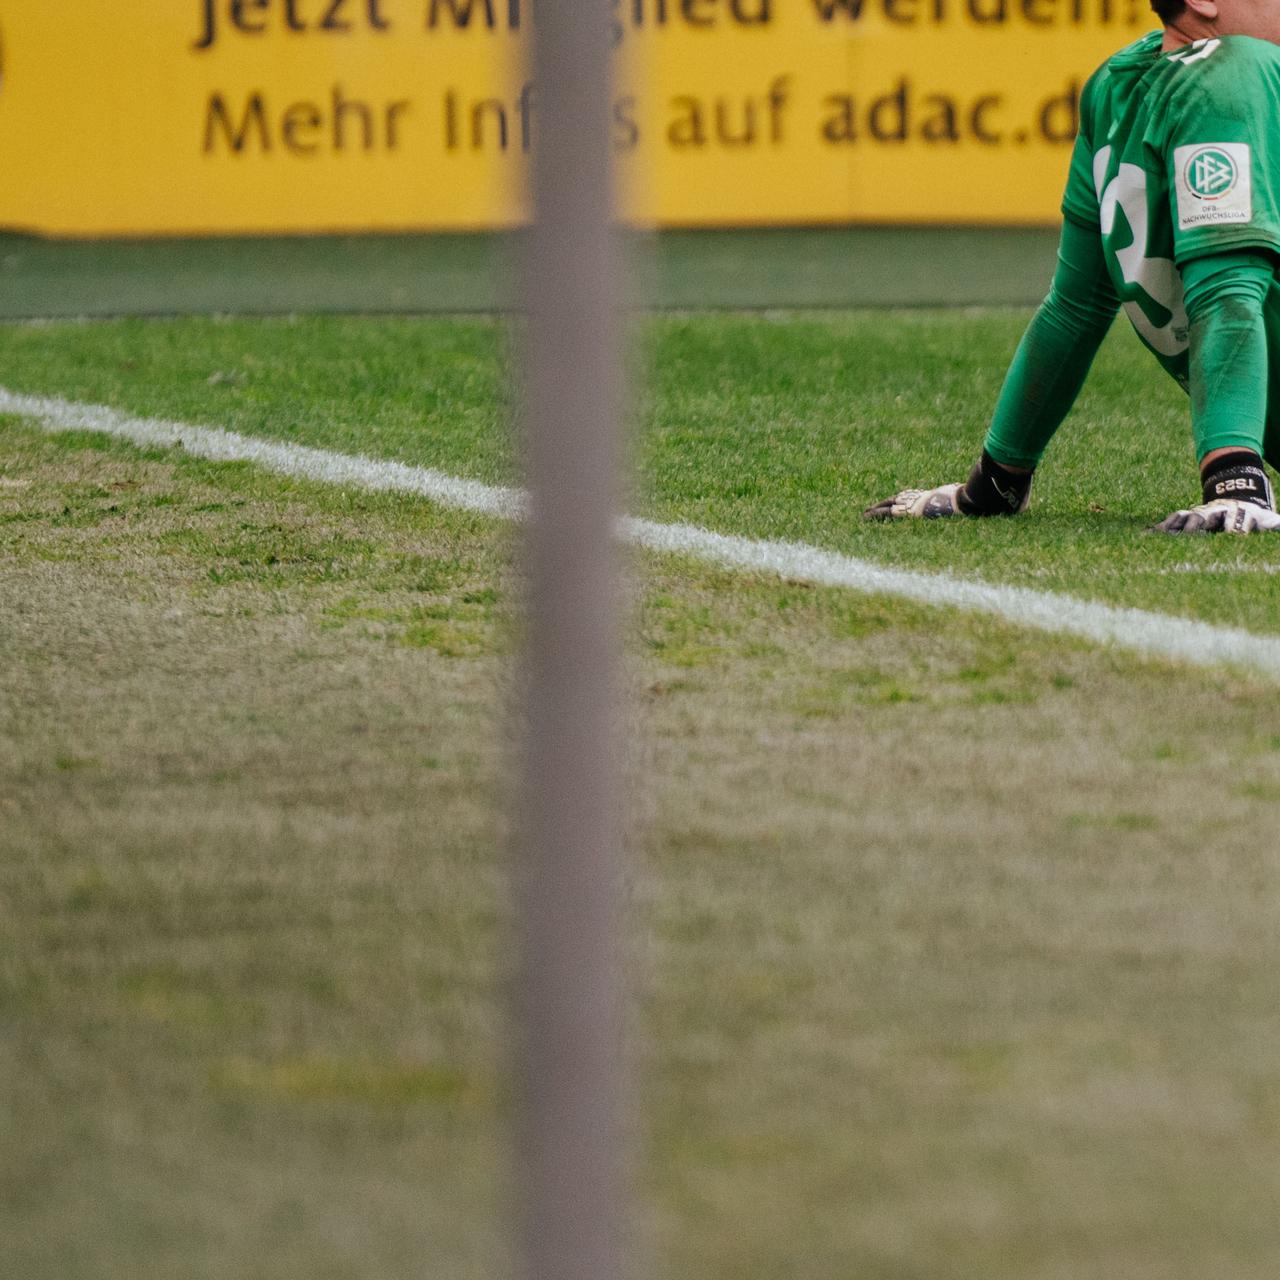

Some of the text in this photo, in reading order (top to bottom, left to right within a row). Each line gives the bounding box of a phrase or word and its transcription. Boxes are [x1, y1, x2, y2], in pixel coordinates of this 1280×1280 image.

[202, 82, 411, 153] Mehr
[445, 79, 640, 152] Infs
[666, 74, 791, 149] auf
[1183, 212, 1245, 223] NACHWUCHSLIGA
